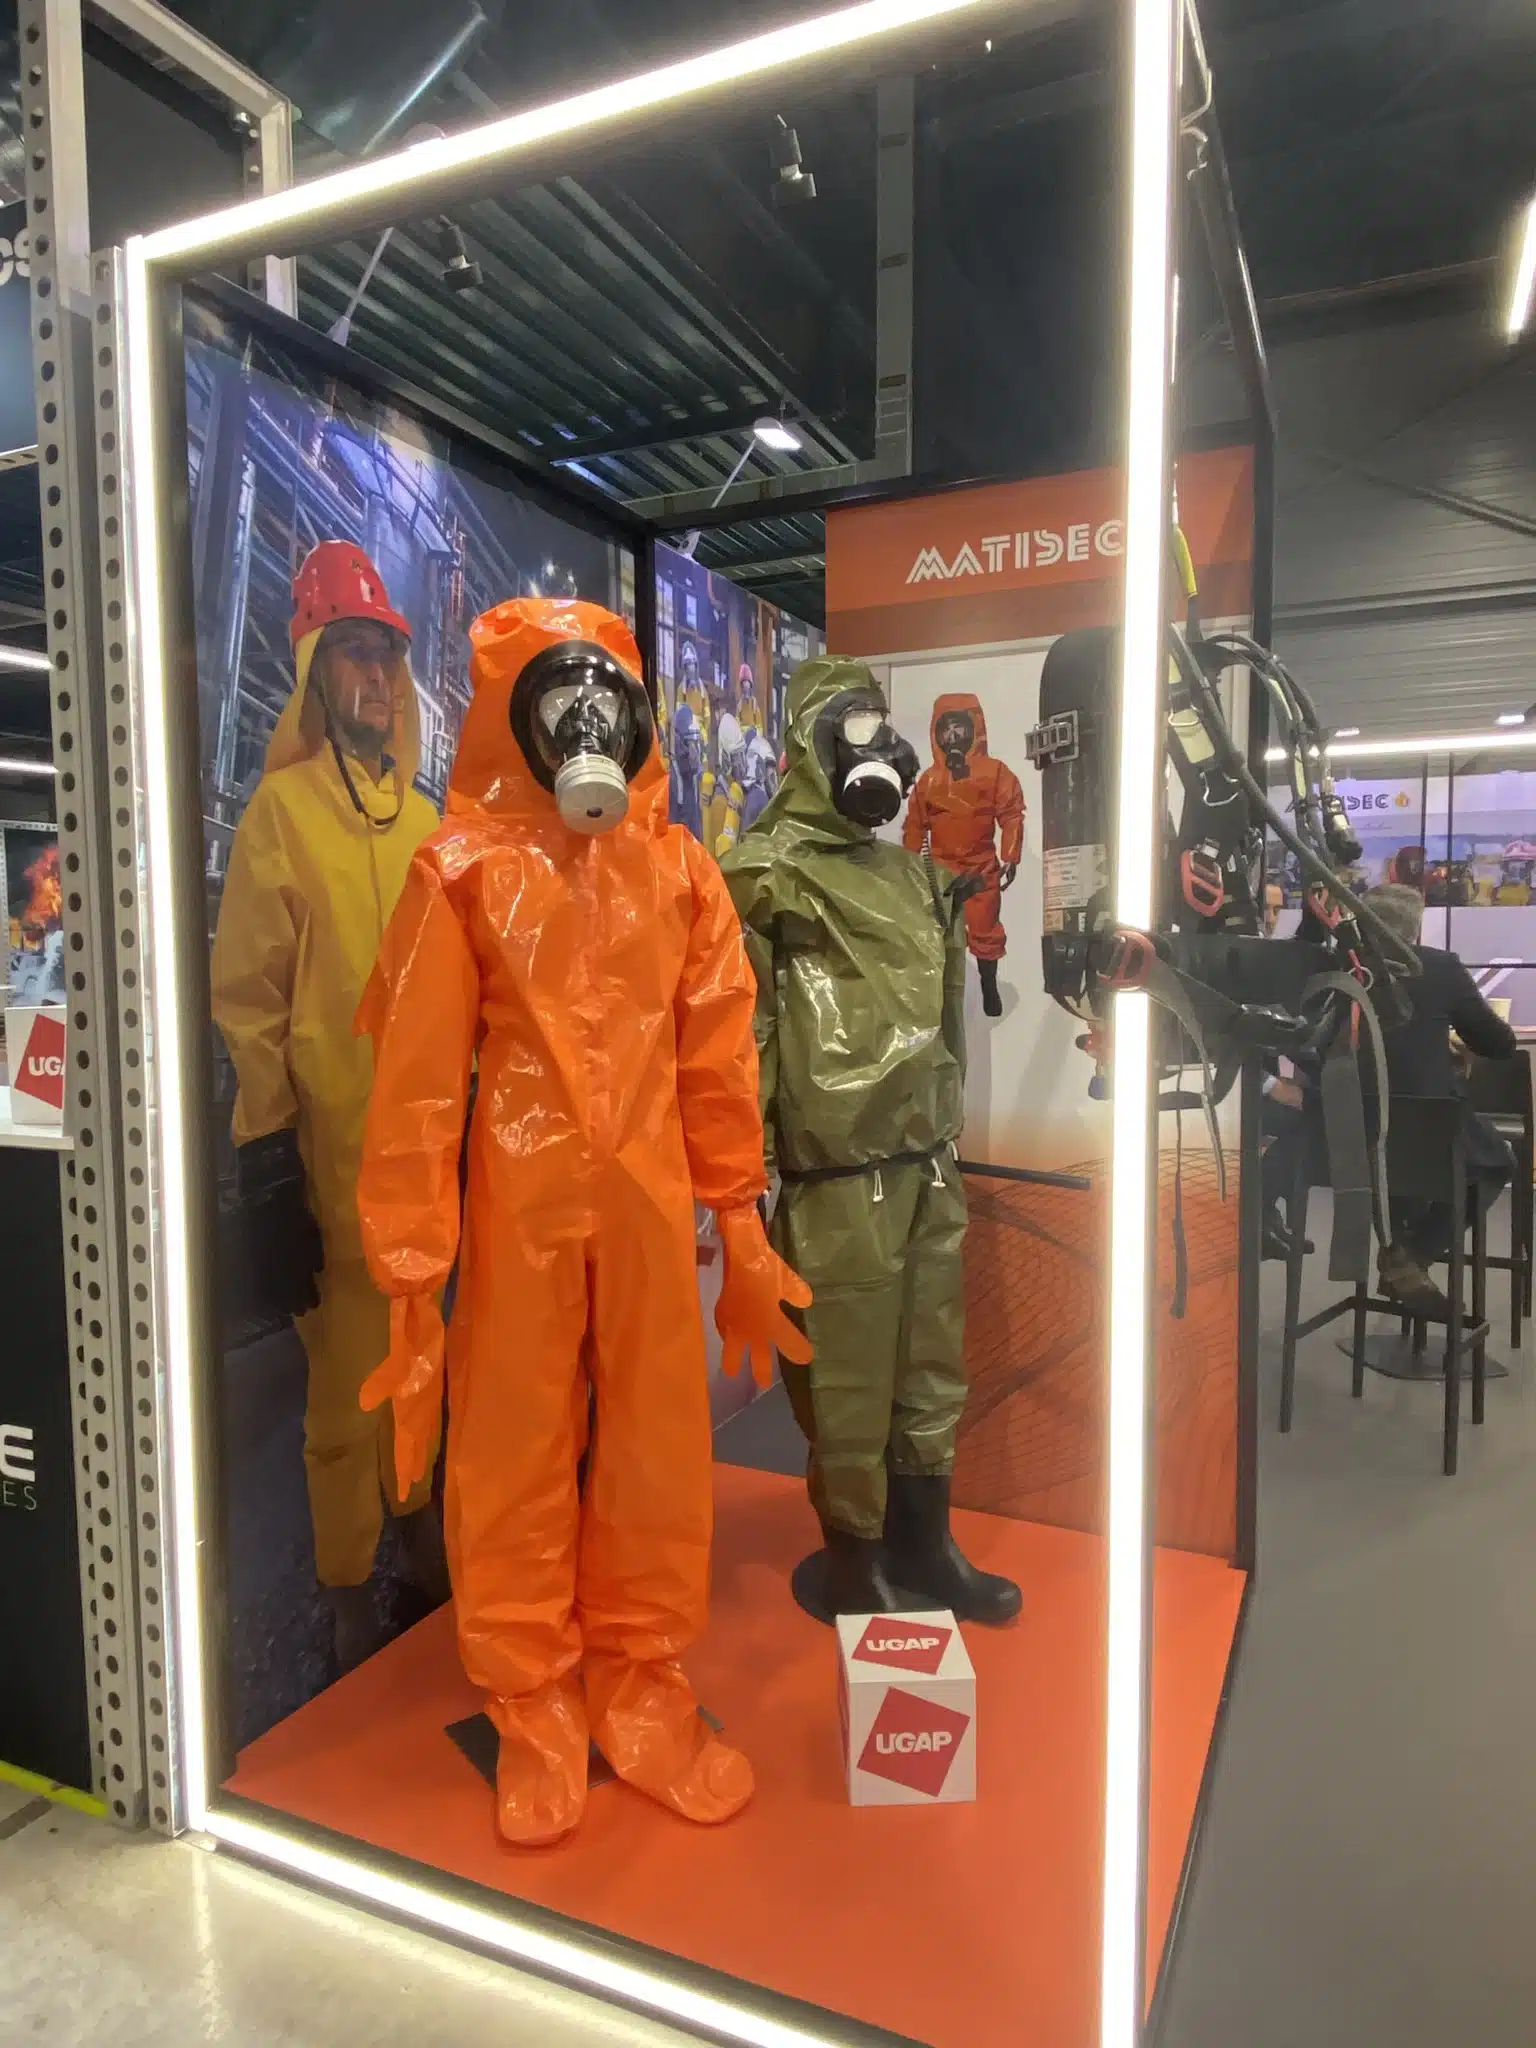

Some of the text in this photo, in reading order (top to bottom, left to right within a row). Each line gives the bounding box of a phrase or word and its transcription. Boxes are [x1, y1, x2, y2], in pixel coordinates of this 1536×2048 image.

[905, 519, 1126, 584] MATISEC
[866, 1637, 940, 1653] UGAP
[876, 1731, 952, 1755] UGAP
